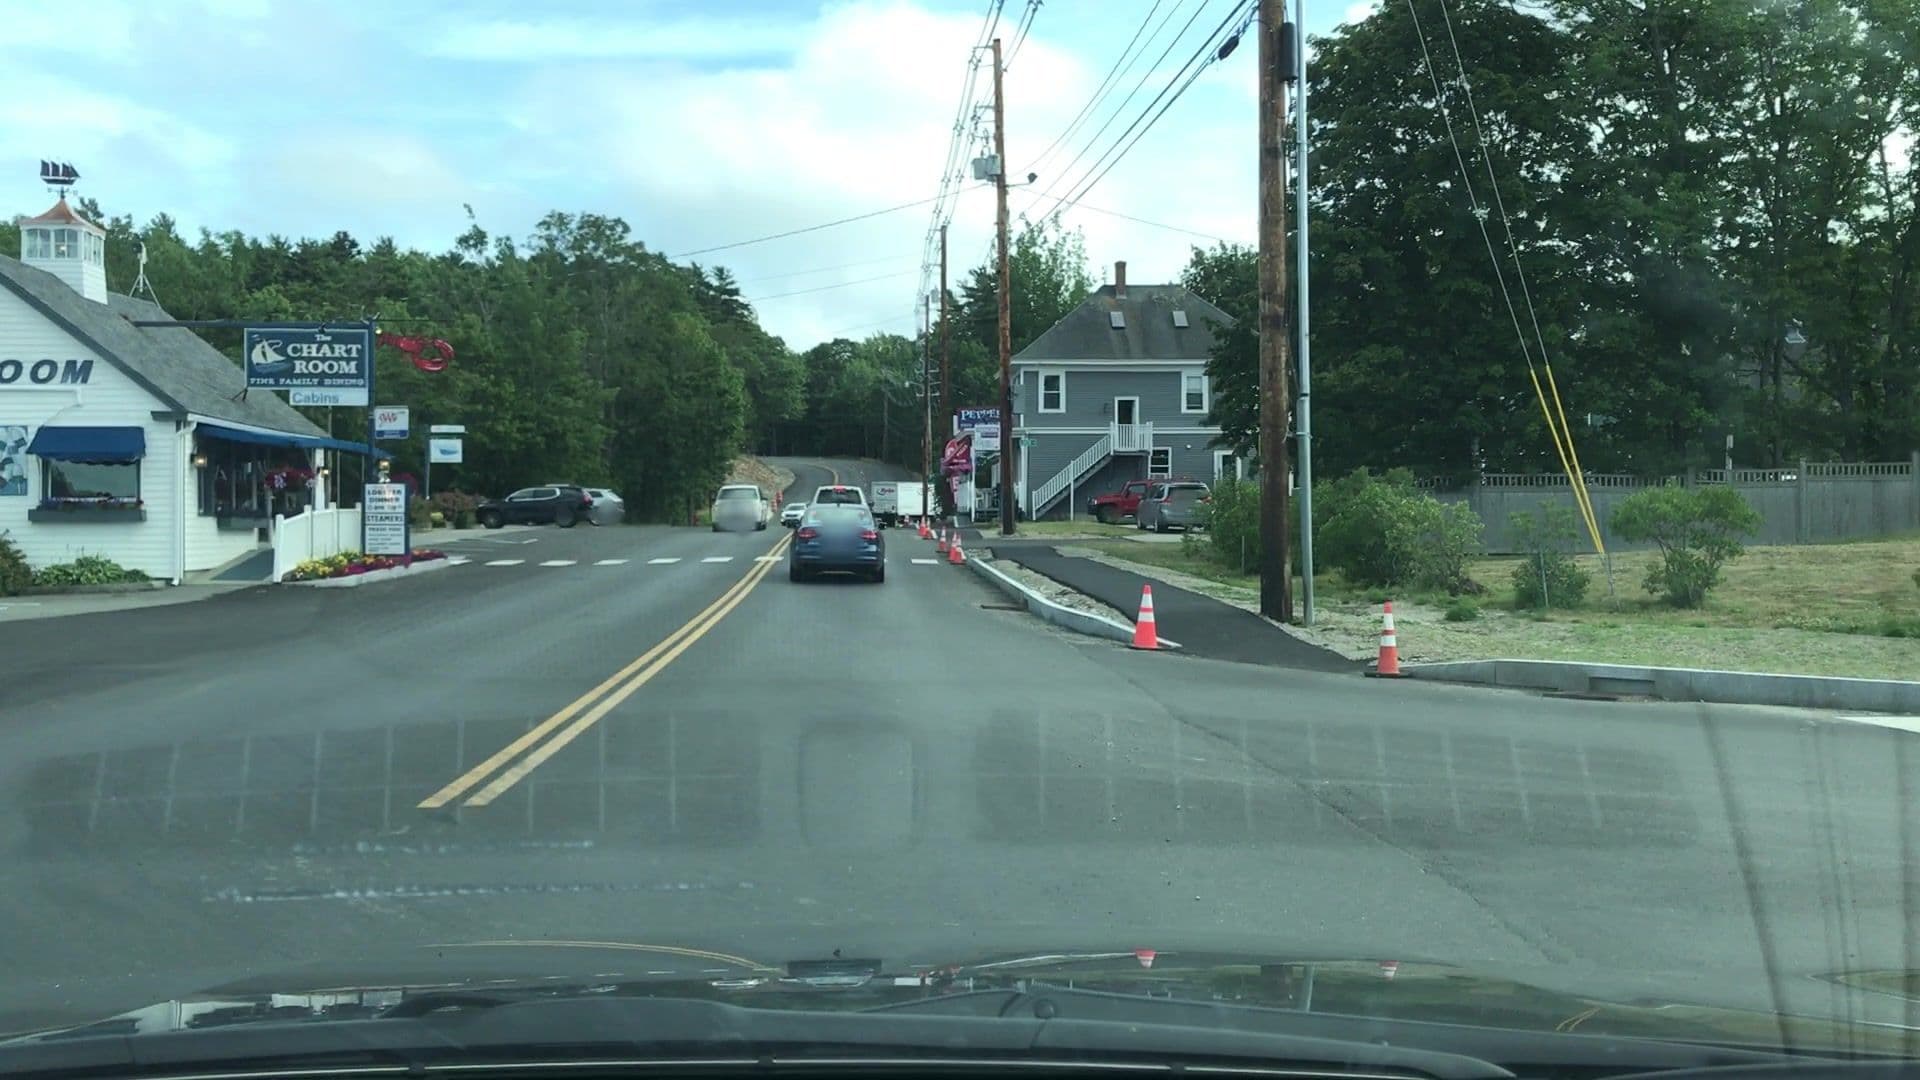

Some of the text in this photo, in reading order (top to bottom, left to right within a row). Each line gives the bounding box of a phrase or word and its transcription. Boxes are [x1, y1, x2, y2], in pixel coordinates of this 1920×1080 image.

[314, 333, 332, 342] The
[286, 343, 362, 357] CHART
[293, 360, 358, 374] ROOM
[323, 378, 364, 386] DINING
[292, 391, 339, 403] Cabins
